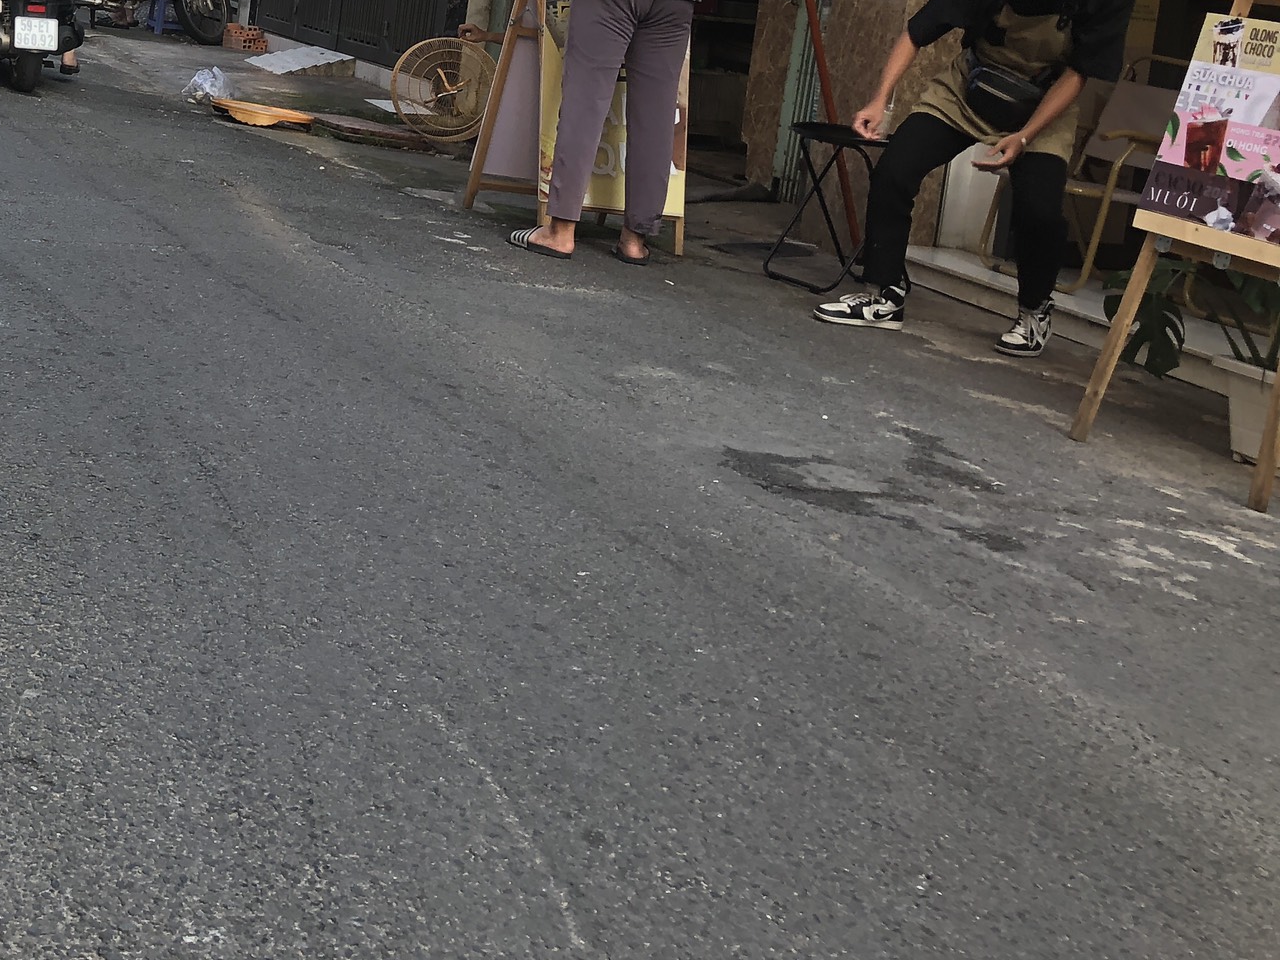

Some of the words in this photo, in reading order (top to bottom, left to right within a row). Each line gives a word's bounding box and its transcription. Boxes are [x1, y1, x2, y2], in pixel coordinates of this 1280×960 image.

[16, 32, 54, 47] 960.92
[1249, 28, 1279, 44] OLONG
[1244, 42, 1275, 58] CHOCO
